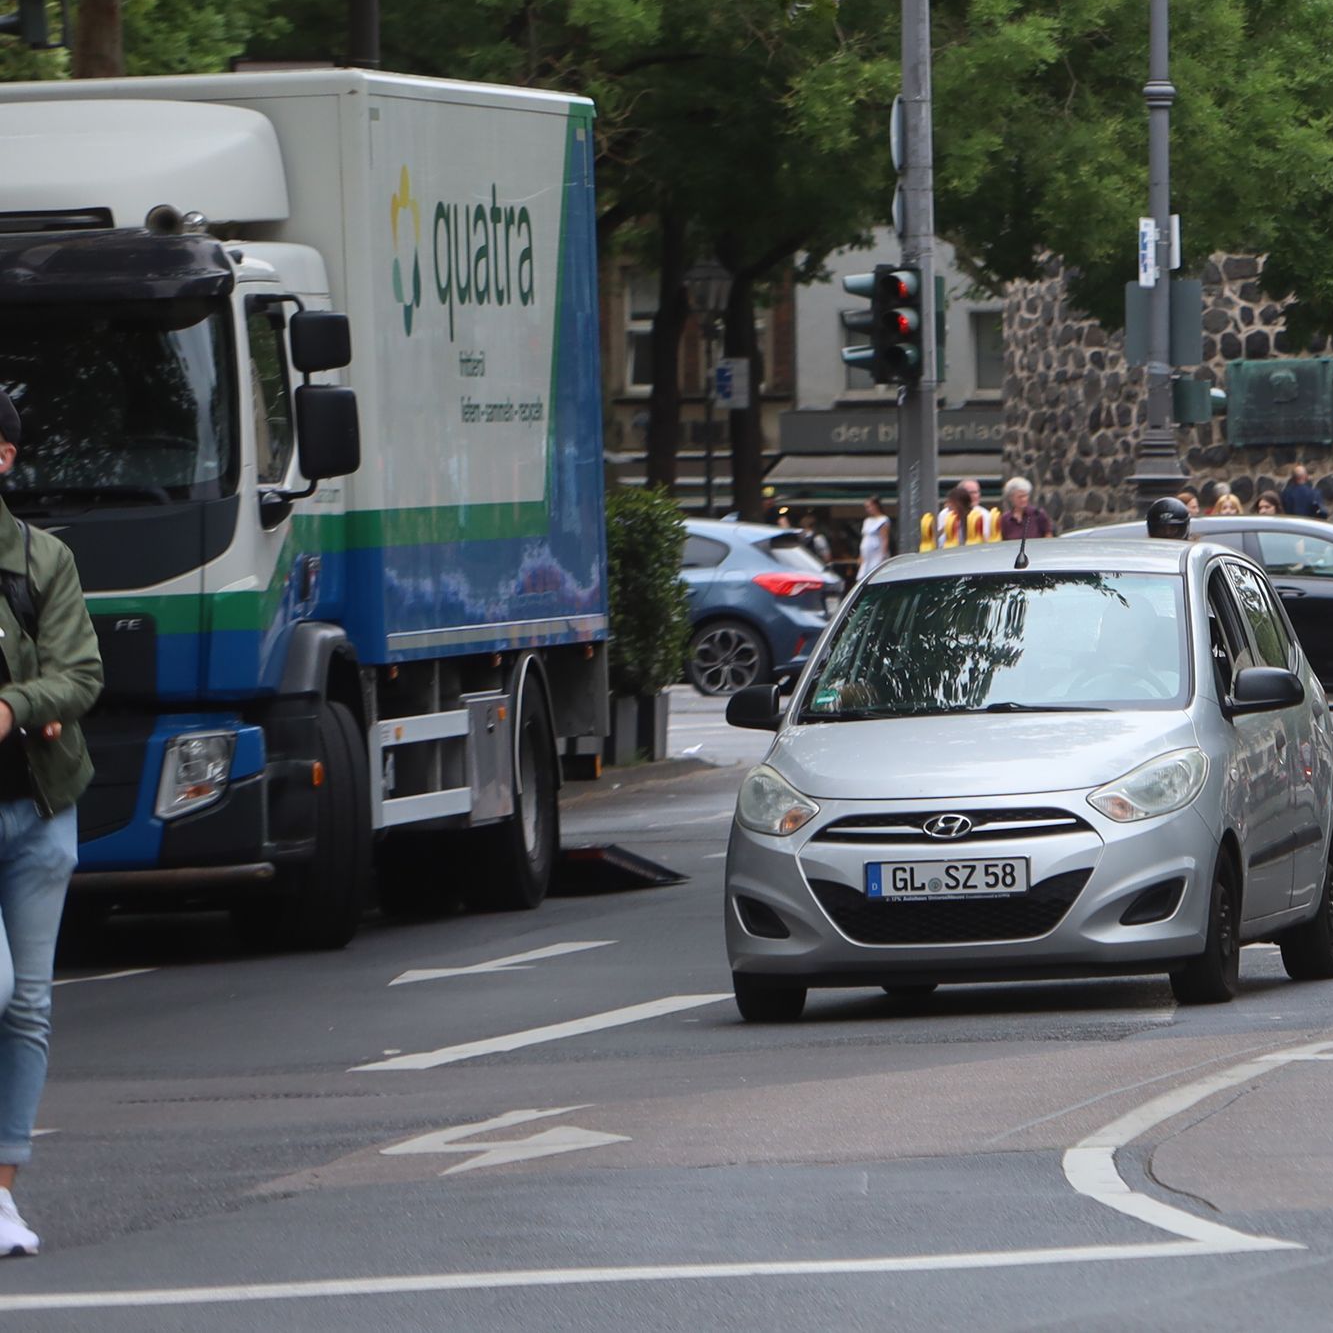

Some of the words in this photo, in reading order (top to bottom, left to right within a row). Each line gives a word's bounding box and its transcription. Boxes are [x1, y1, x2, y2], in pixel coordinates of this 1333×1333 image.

[433, 182, 535, 343] quatra
[831, 422, 872, 443] der
[115, 619, 143, 631] FE
[892, 866, 926, 892] GL
[944, 864, 978, 890] SZ
[984, 863, 1016, 889] 58
